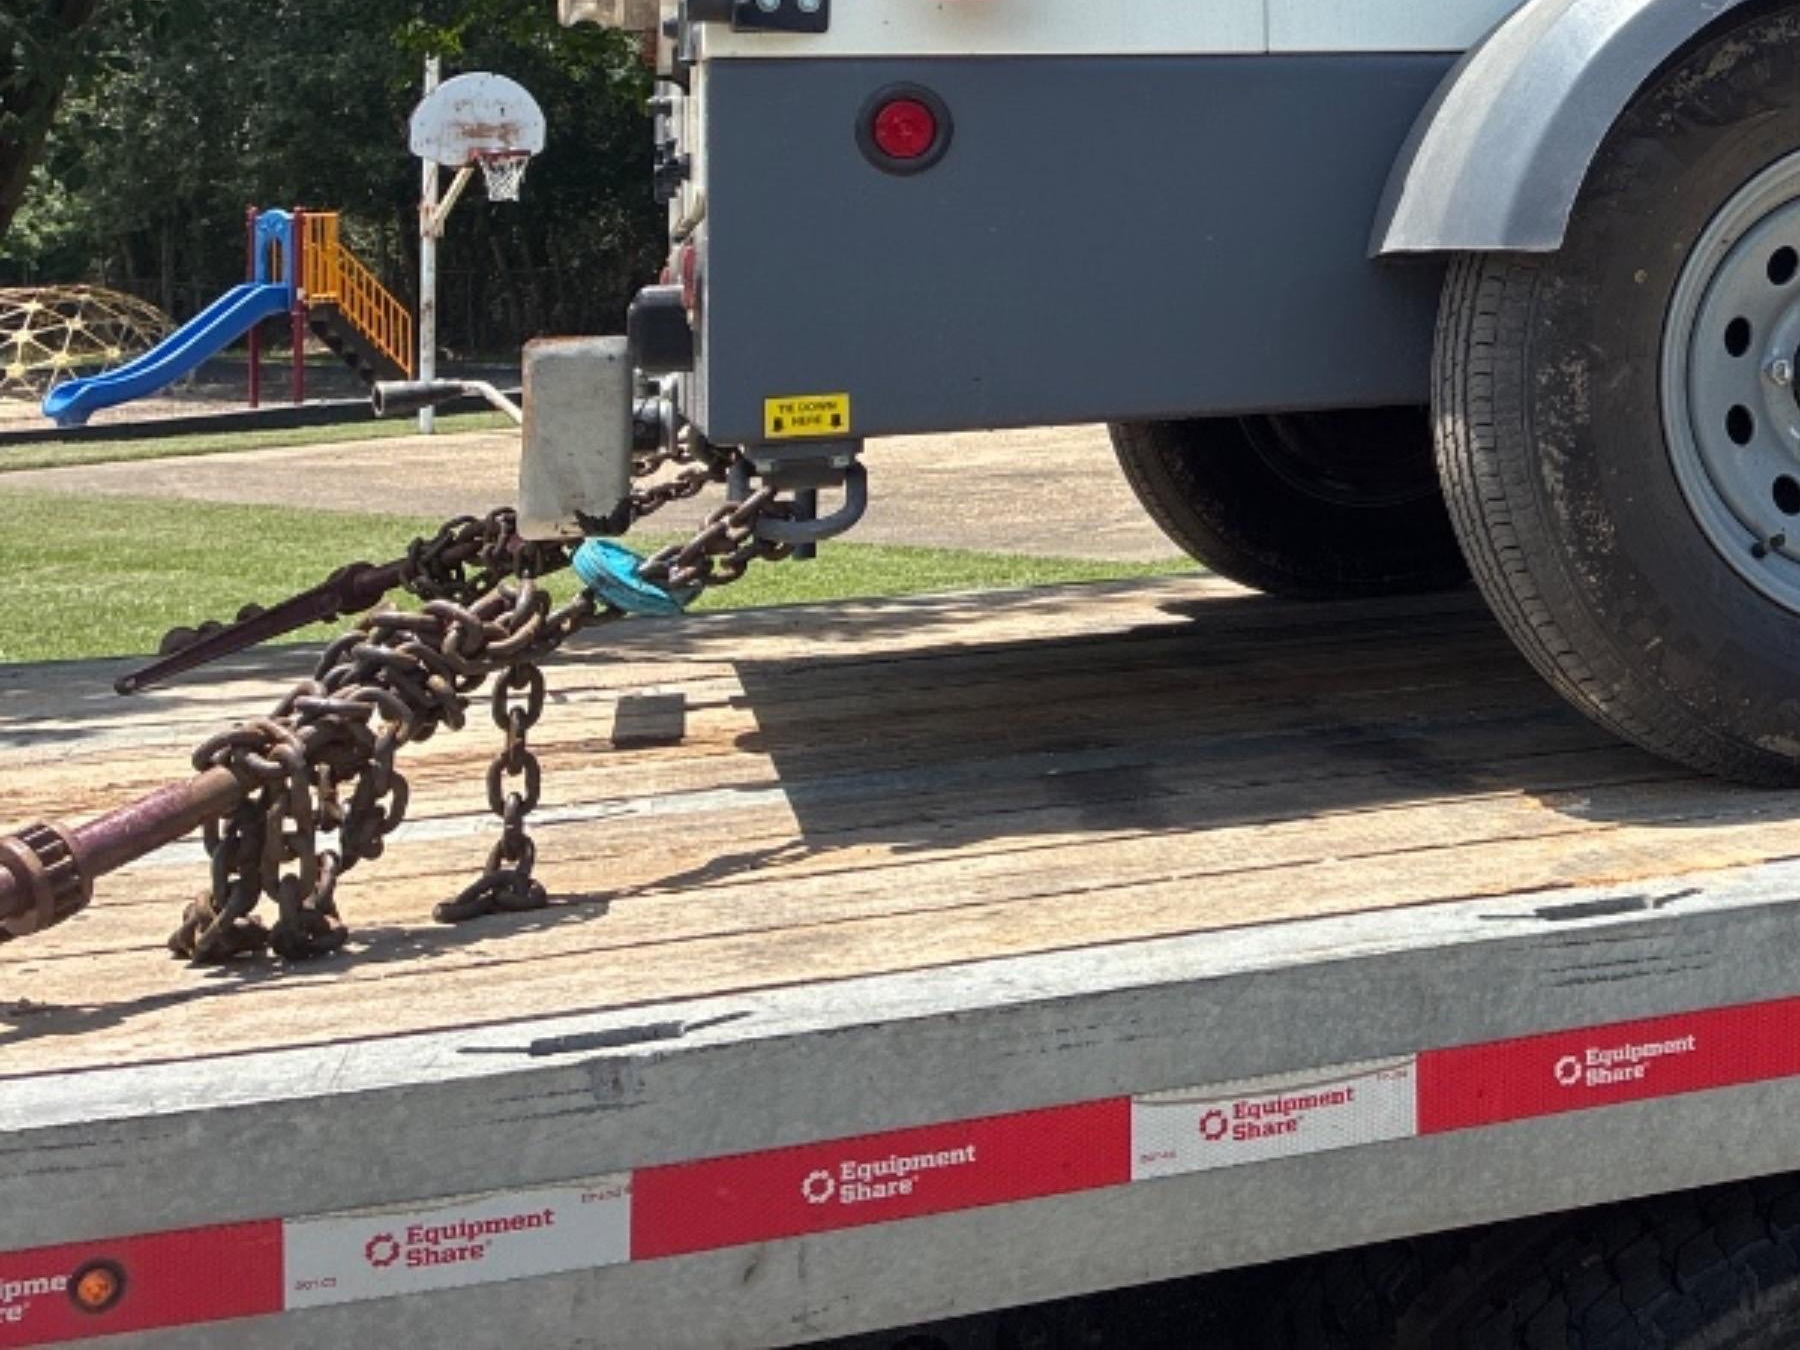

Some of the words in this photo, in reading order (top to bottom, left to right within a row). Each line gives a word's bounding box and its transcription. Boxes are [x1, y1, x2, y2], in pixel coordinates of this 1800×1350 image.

[1585, 1033, 1697, 1066] Equipment
[1585, 1063, 1645, 1088] Share
[1231, 1086, 1355, 1120] Equipment
[1232, 1116, 1298, 1141] Share
[839, 1143, 977, 1182] Equipment
[839, 1177, 913, 1204] Share
[404, 1207, 556, 1246] Equipment
[405, 1242, 485, 1268] Share
